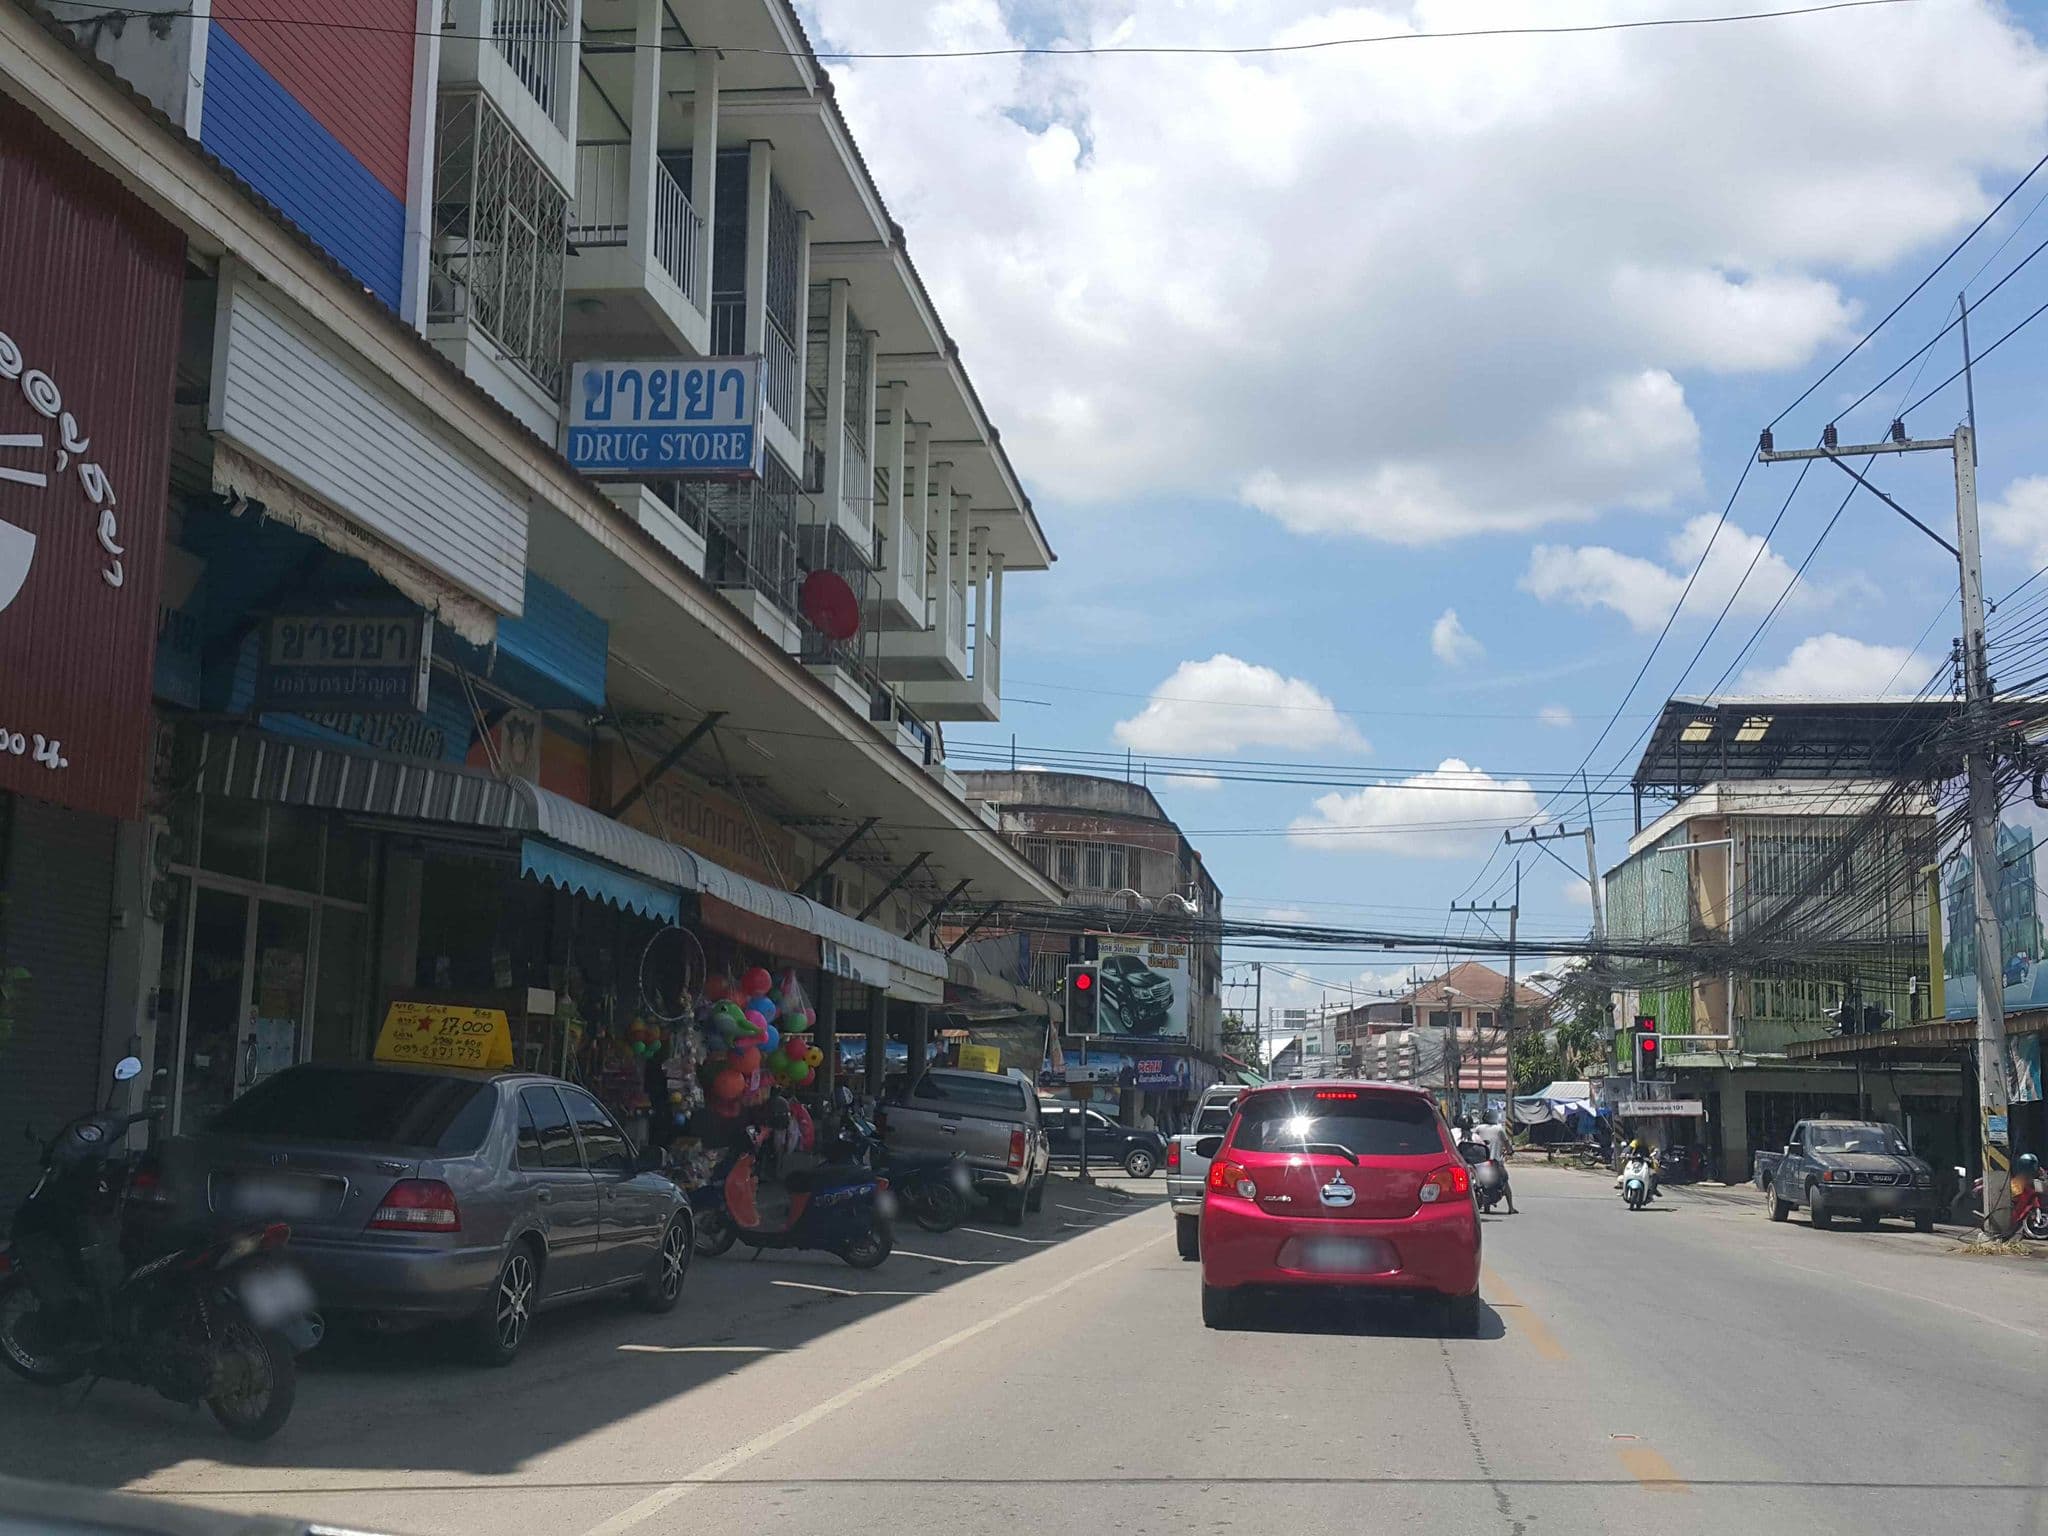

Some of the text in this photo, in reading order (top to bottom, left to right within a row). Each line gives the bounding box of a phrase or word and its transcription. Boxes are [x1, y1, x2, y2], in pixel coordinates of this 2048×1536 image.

[582, 368, 745, 420] ขายยา
[574, 433, 746, 462] DRUG STORE
[281, 622, 408, 659] ขายยา
[1643, 1019, 1654, 1031] 4
